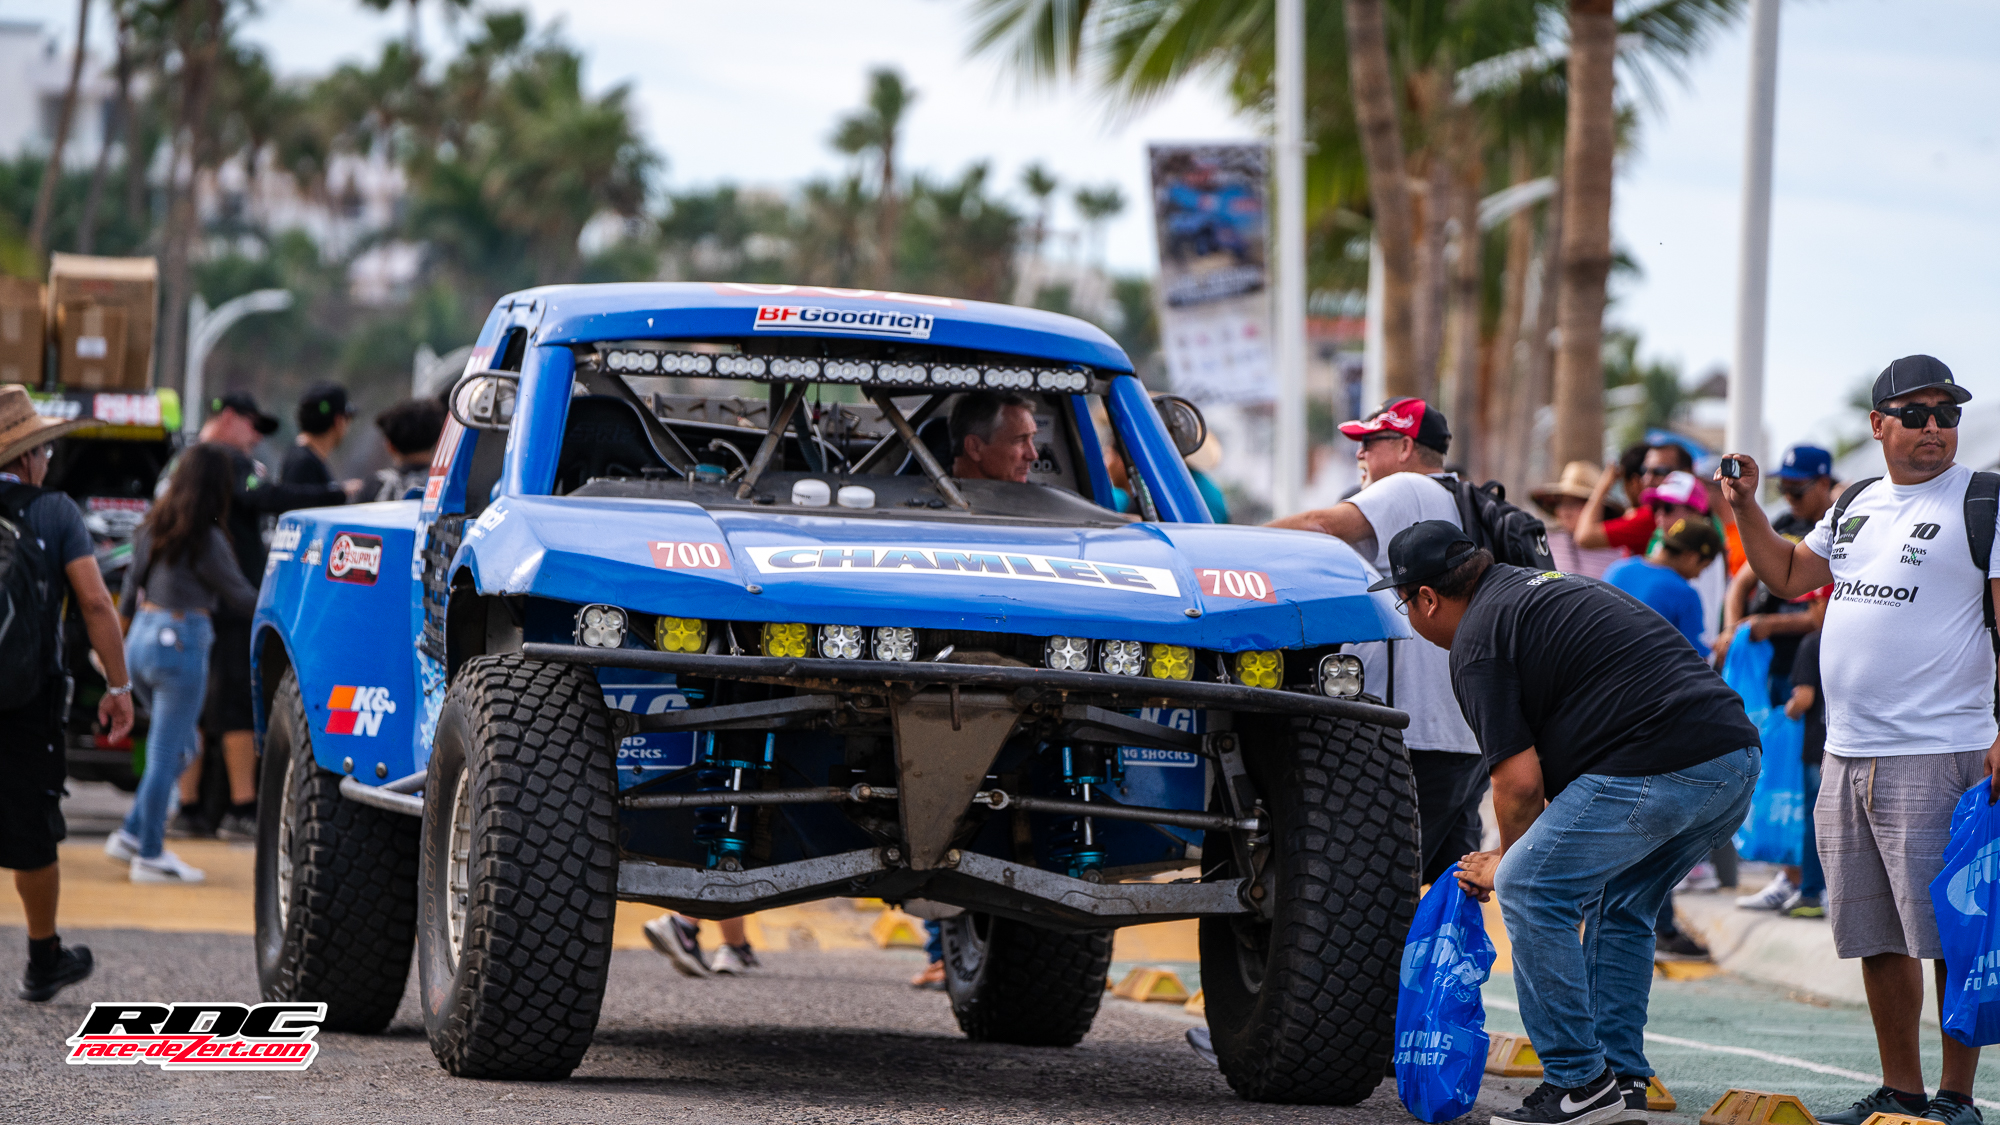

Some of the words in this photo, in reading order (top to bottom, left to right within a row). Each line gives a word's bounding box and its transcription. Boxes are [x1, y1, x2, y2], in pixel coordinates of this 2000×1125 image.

[758, 307, 931, 330] BFGoodrich
[1909, 522, 1941, 540] 10
[350, 550, 378, 567] SUPPLY
[656, 542, 721, 568] 700
[1902, 544, 1927, 556] Papas
[767, 549, 1156, 590] CHAMLEE
[1900, 555, 1923, 567] Beer
[1202, 569, 1267, 600] 700
[1842, 596, 1863, 604] BANCO
[1873, 598, 1902, 608] MÉXICO
[353, 711, 384, 737] N
[1141, 750, 1191, 761] SHOCKS
